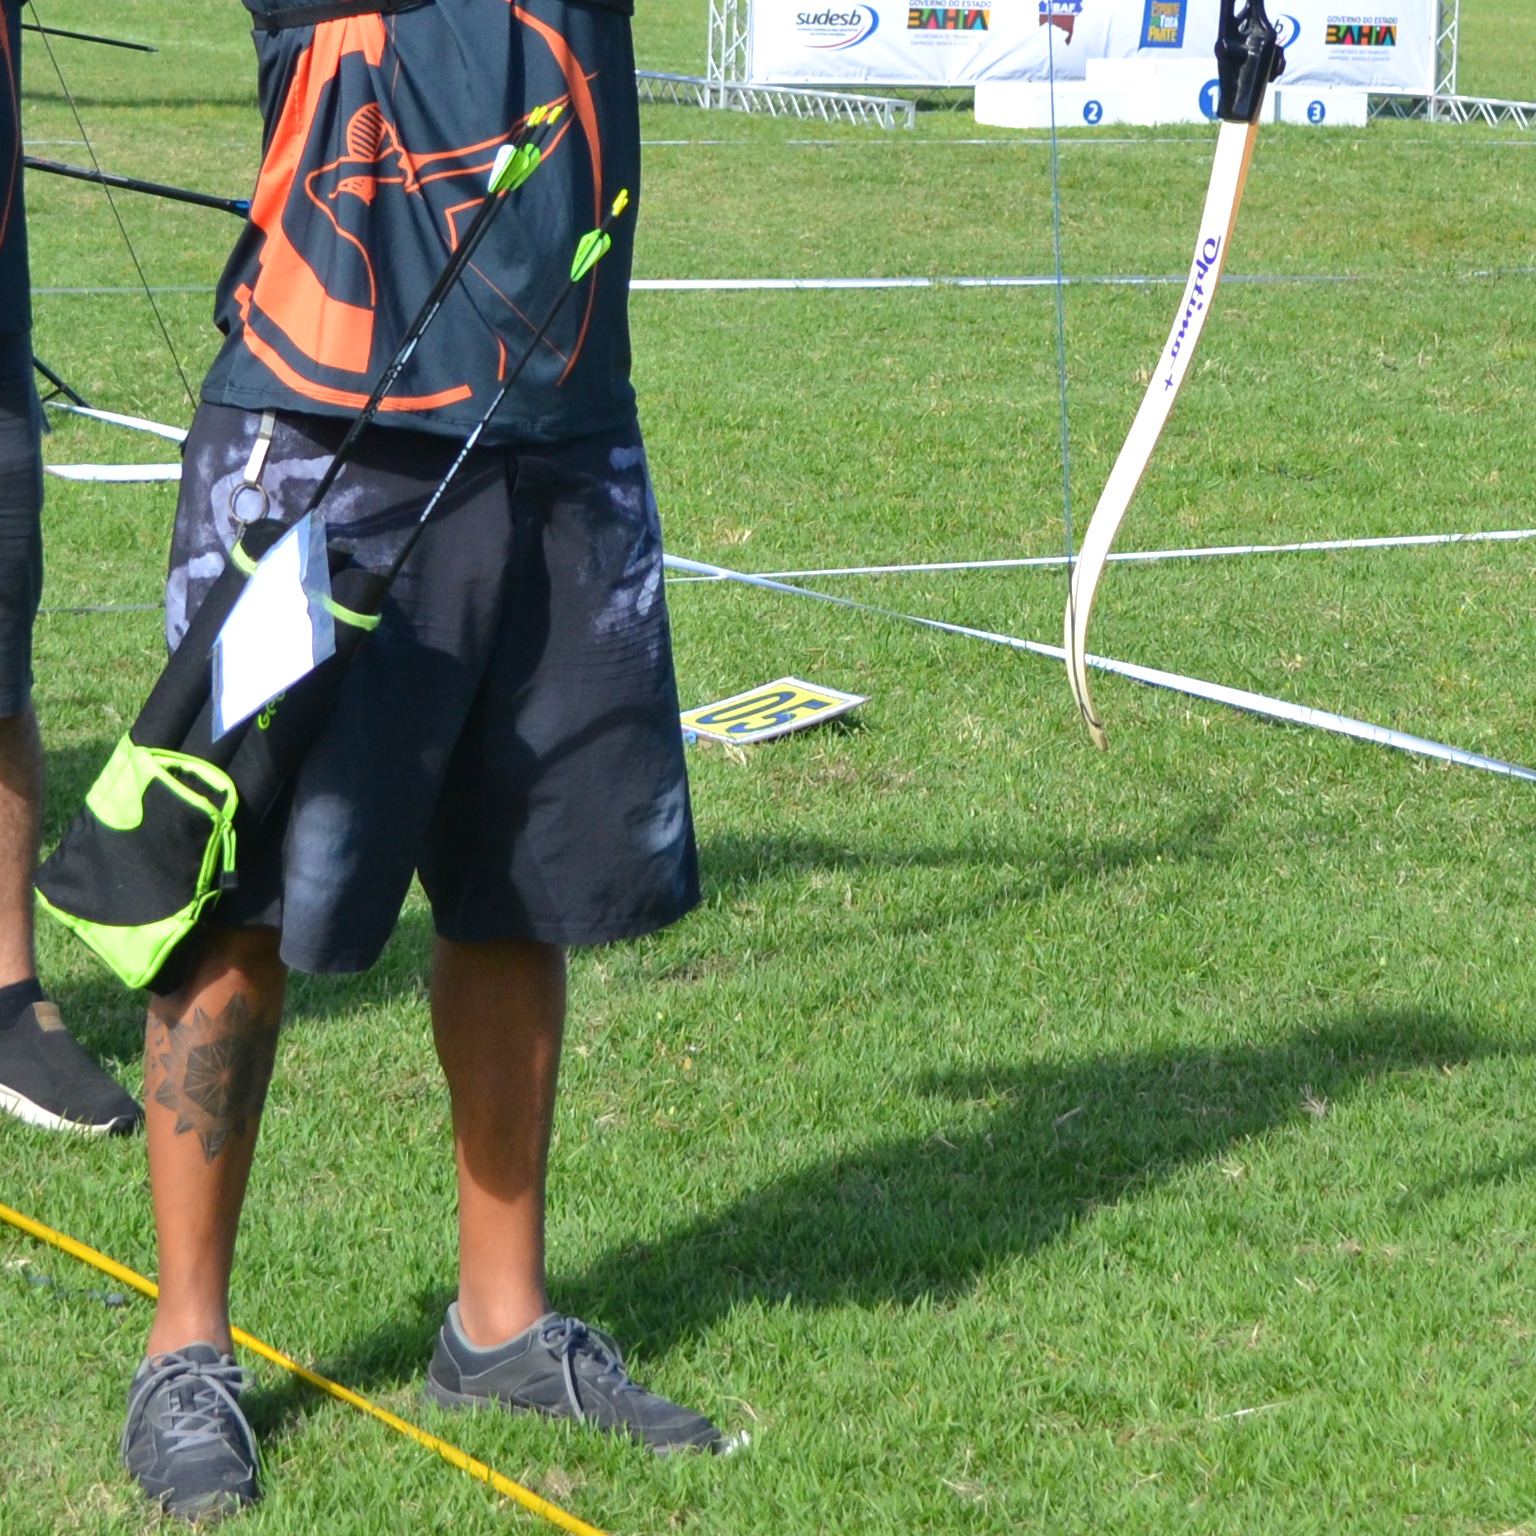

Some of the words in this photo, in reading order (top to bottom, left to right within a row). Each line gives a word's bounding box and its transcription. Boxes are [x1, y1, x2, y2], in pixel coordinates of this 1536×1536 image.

[949, 0, 960, 8] DO
[962, 0, 992, 9] ESTADO
[796, 9, 862, 27] sudesb
[1087, 103, 1098, 121] 2
[1311, 102, 1321, 121] 3
[1171, 235, 1221, 358] Optimo
